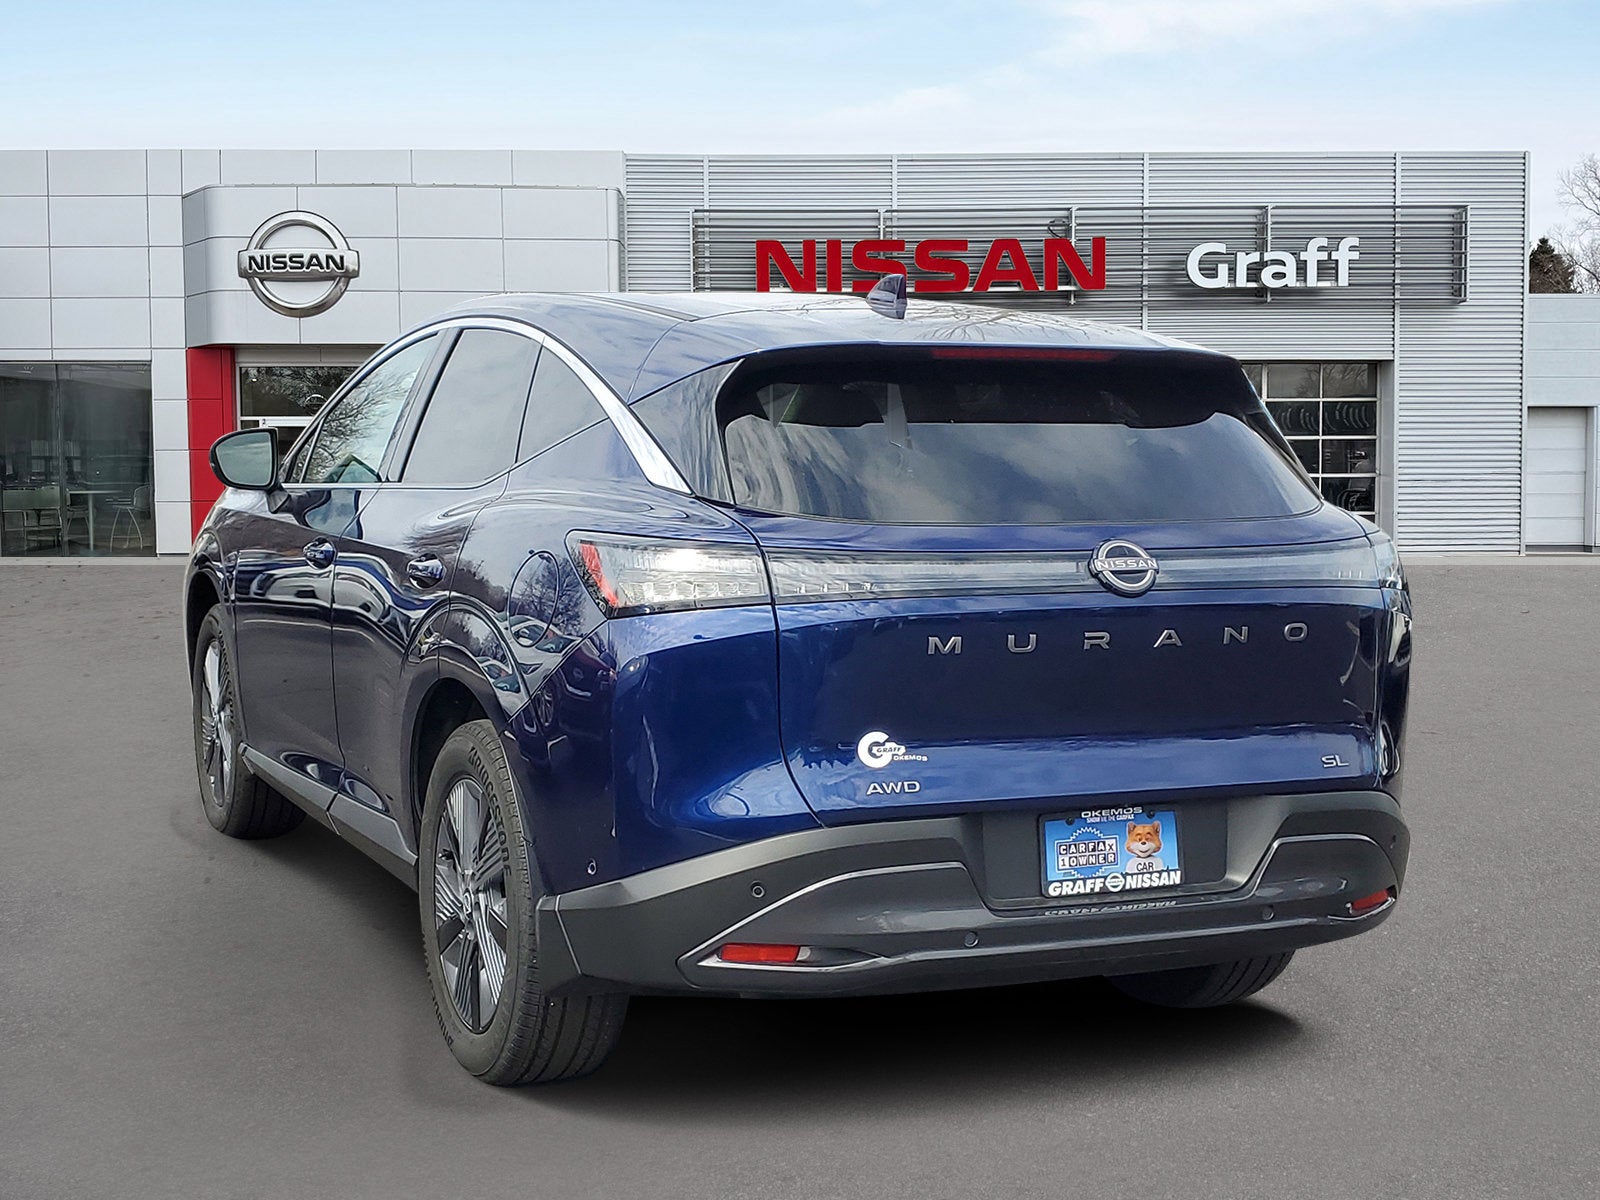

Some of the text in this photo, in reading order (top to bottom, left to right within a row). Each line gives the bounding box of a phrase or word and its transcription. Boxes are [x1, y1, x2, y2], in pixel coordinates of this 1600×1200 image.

[248, 253, 345, 272] NISSAN
[755, 236, 1360, 293] NISSAN Graff
[1097, 559, 1158, 570] NISSAN
[926, 621, 1309, 655] MURANO
[893, 754, 928, 762] OKEMOS
[1321, 754, 1349, 768] SL
[866, 781, 921, 796] AWD
[1081, 806, 1143, 819] OKEMOS
[1059, 841, 1116, 855] CARFAX
[1136, 861, 1155, 871] CAR
[1048, 870, 1181, 897] GRAFF NISSAN
